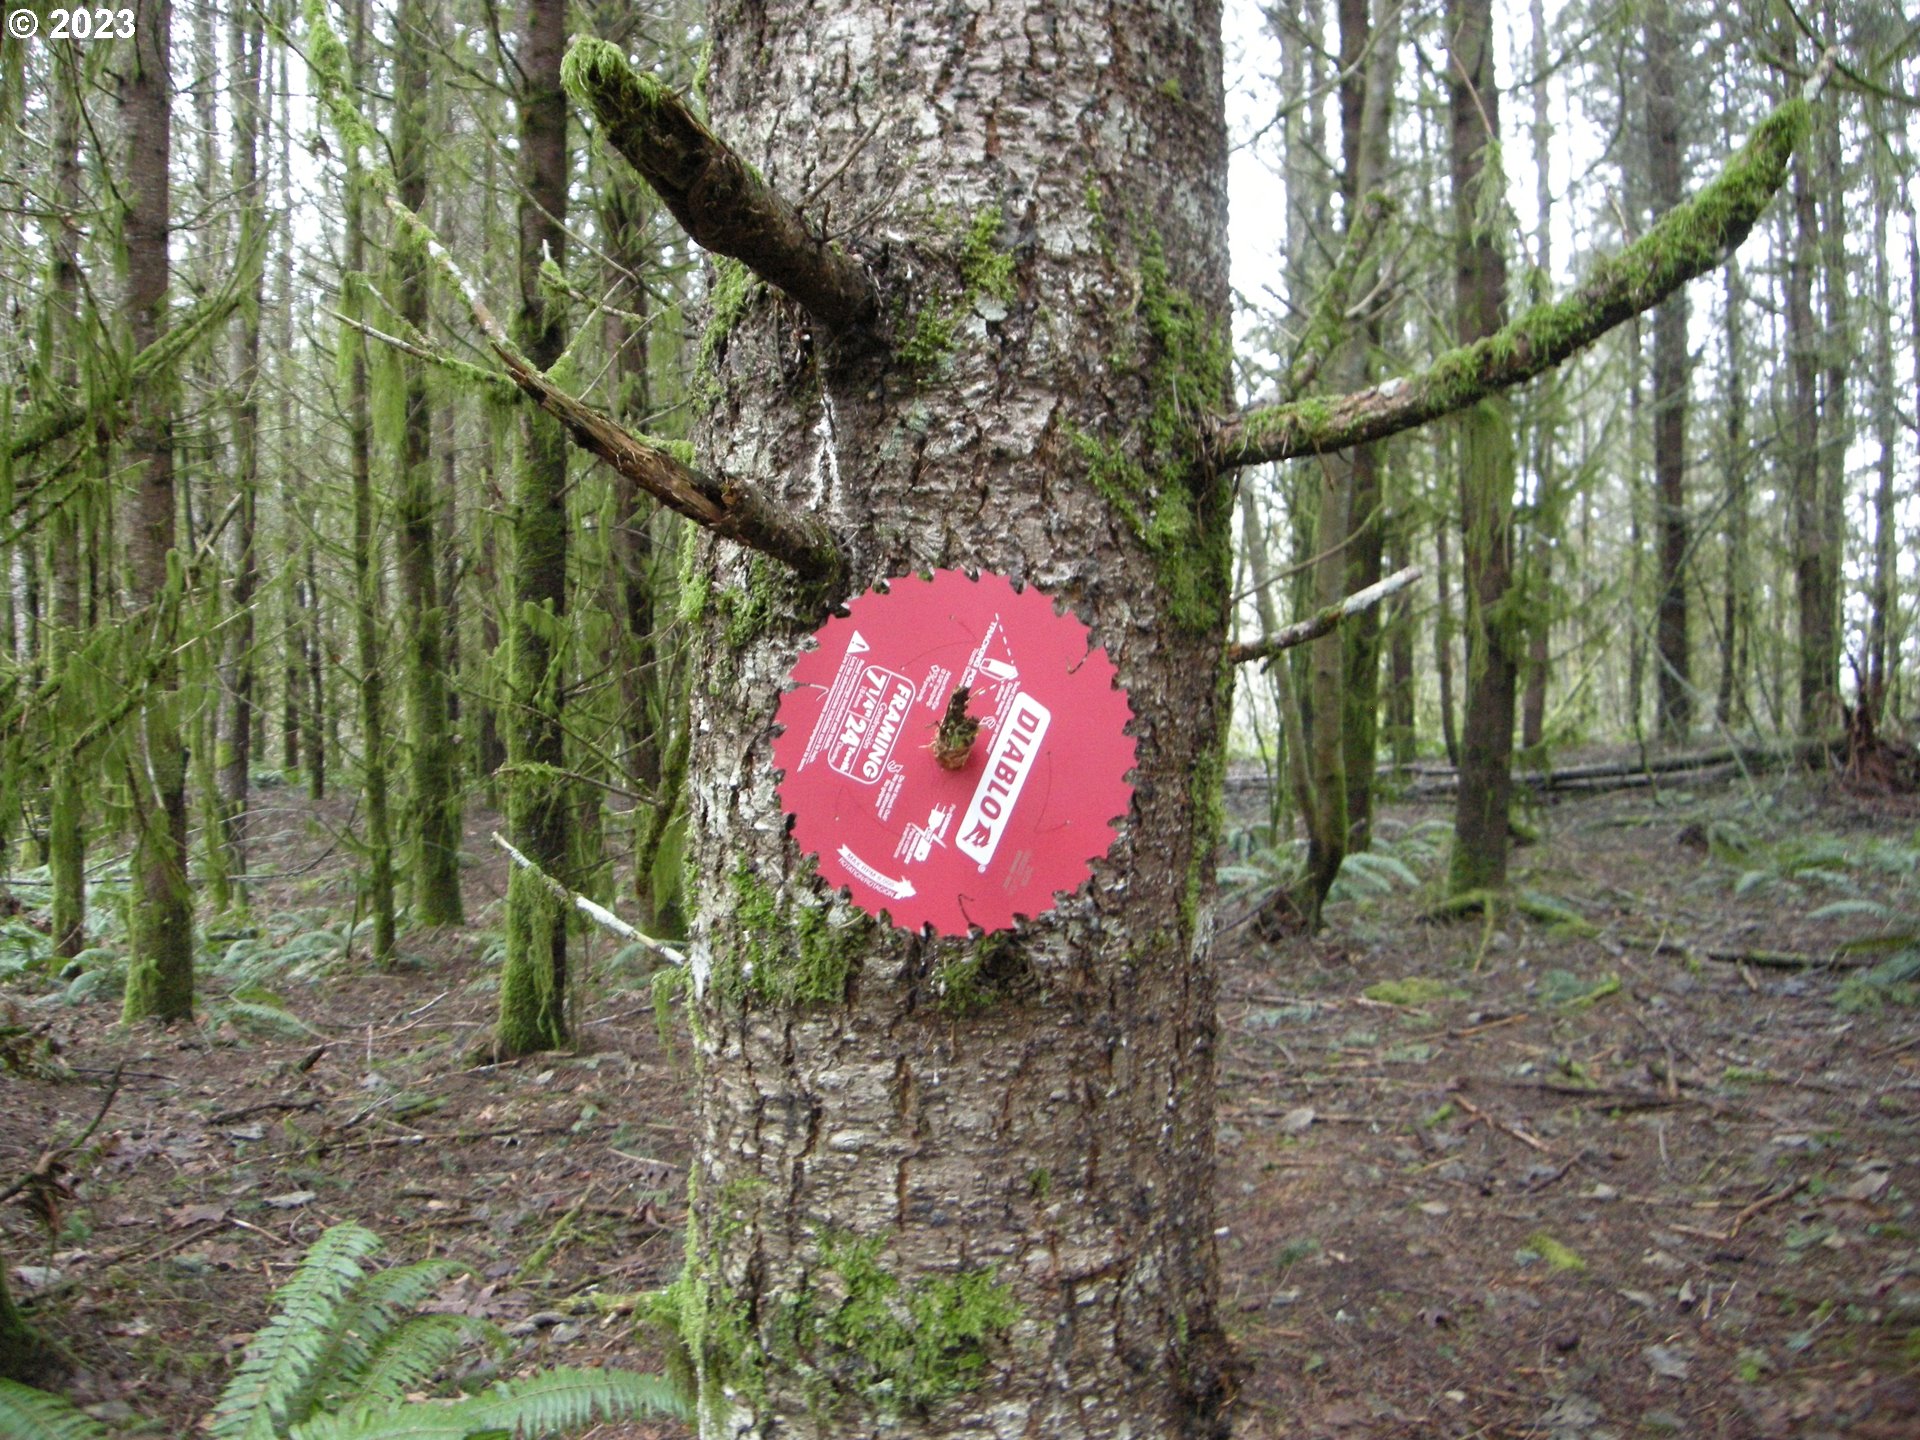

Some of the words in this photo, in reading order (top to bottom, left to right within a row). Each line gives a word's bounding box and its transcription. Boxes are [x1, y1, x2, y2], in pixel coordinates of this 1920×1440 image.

[972, 621, 997, 668] TRACKING
[866, 667, 887, 690] 7
[839, 713, 864, 748] 24
[862, 683, 914, 781] FRAMING
[979, 707, 1039, 820] DIABLO
